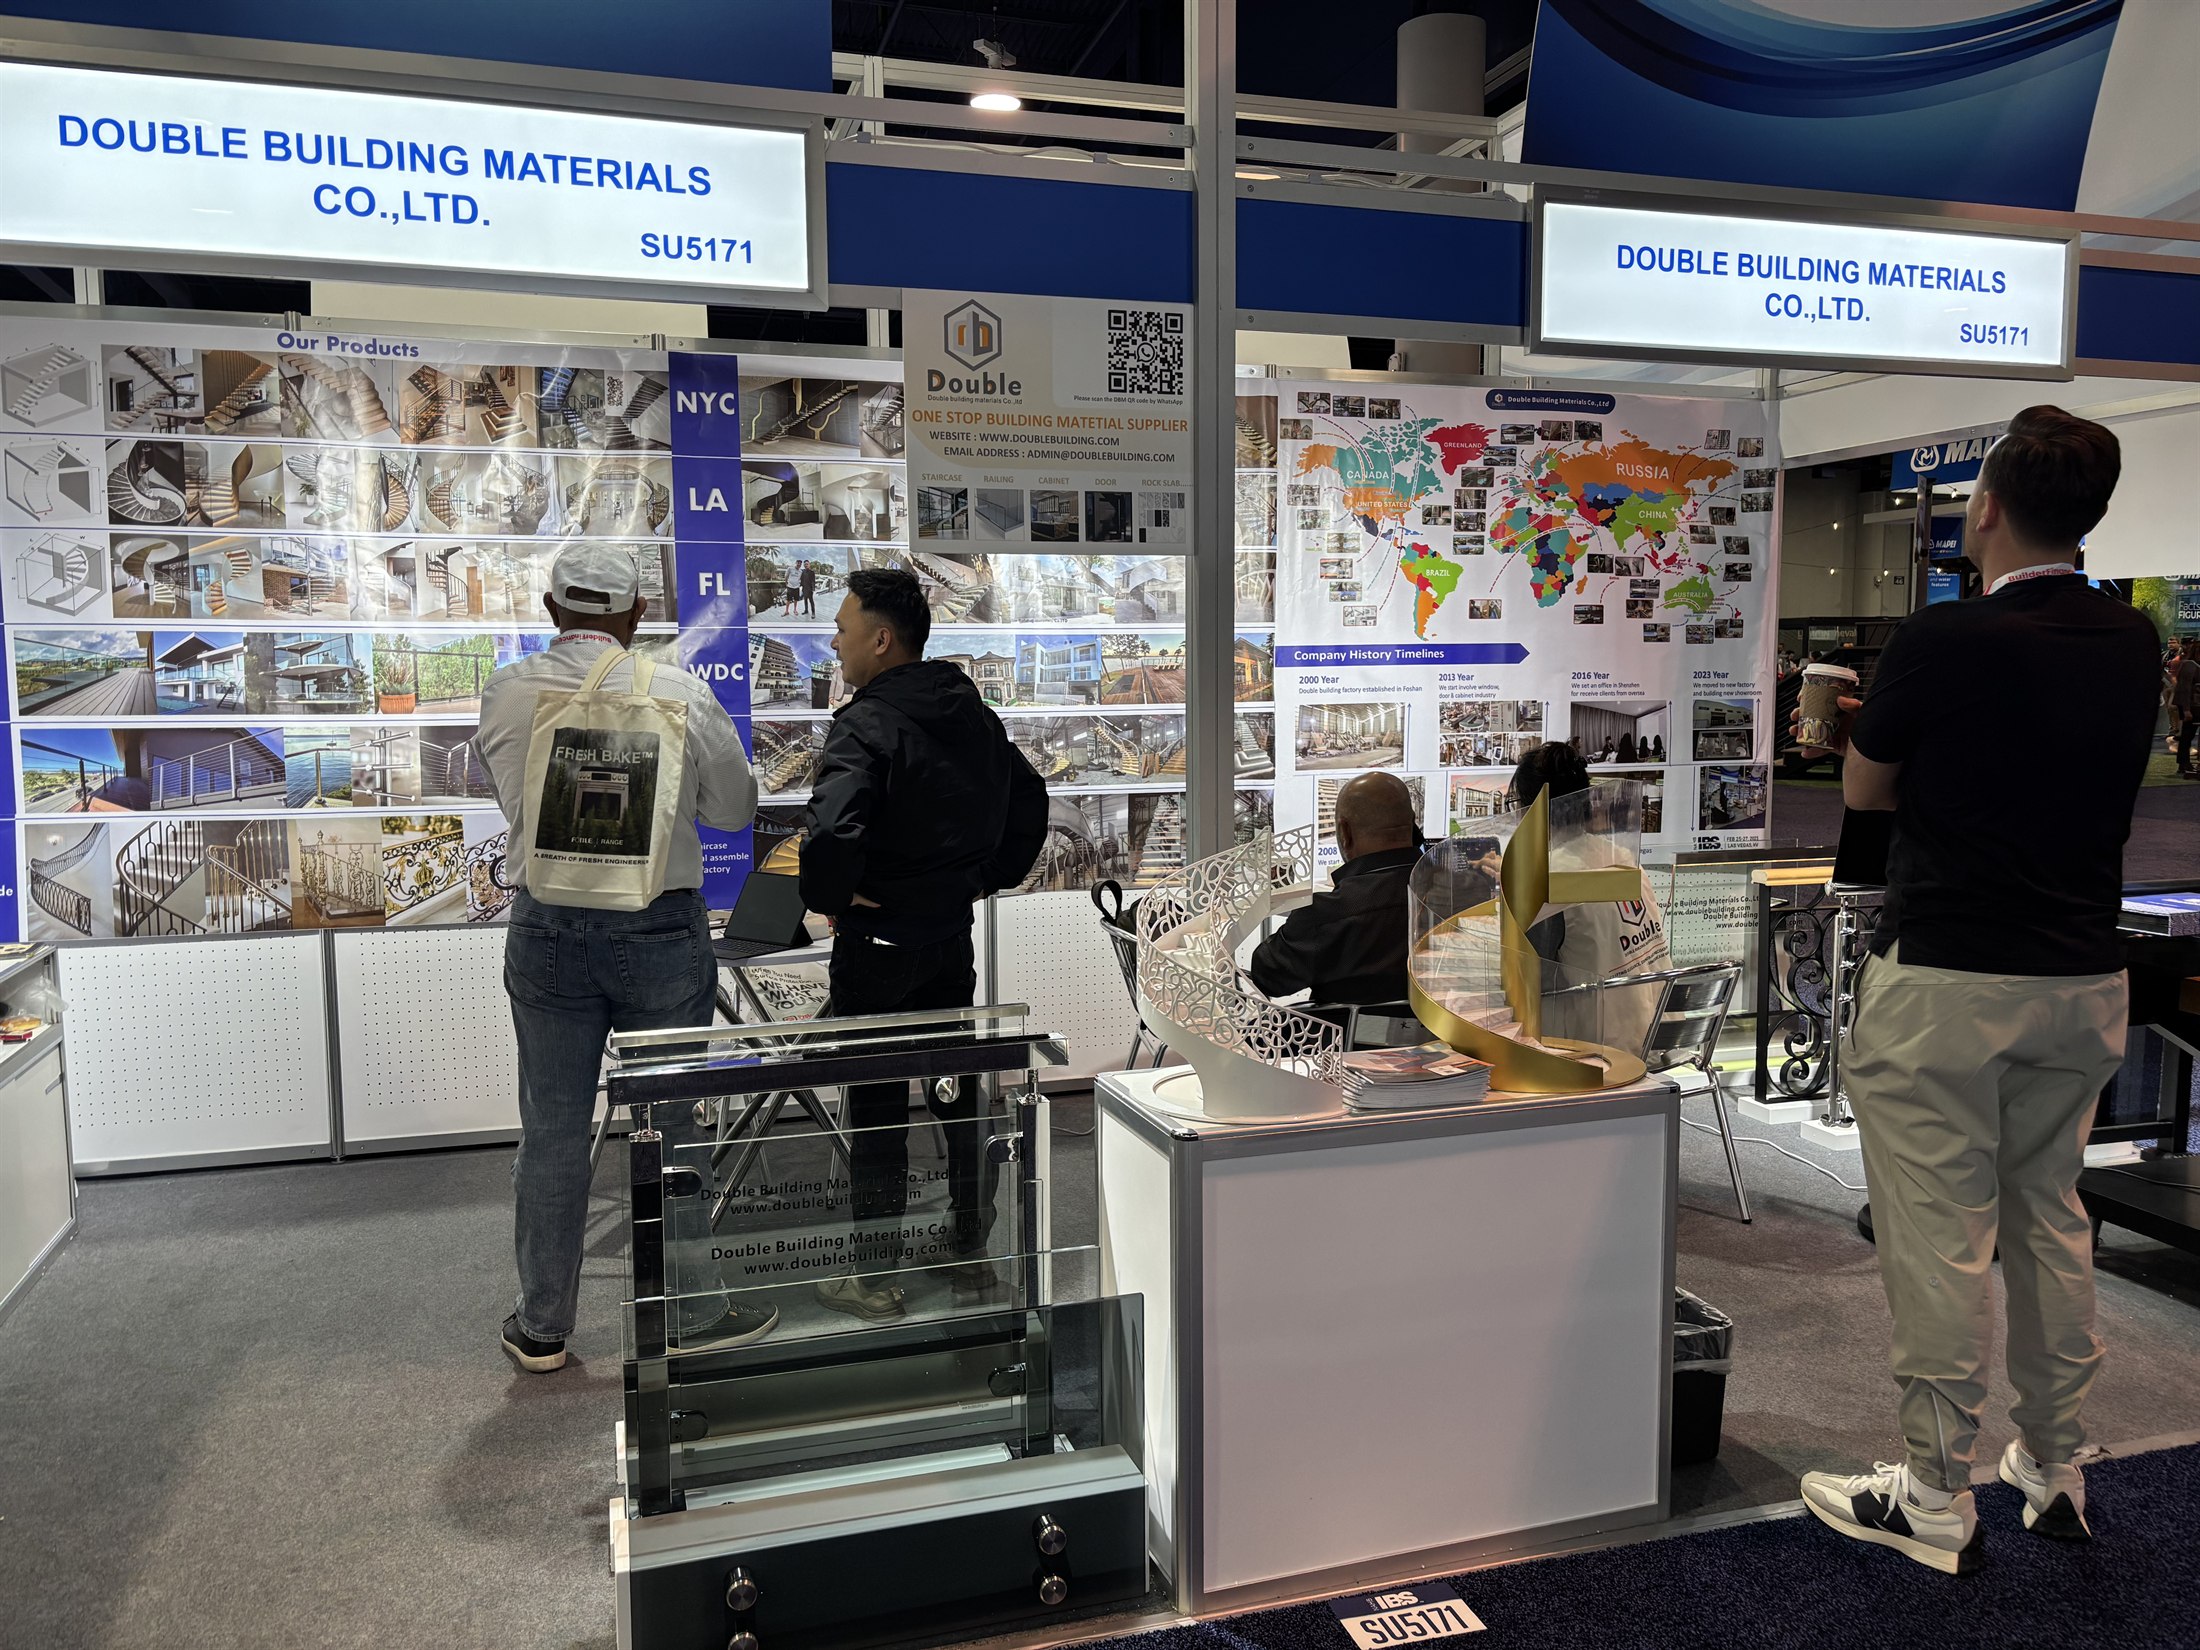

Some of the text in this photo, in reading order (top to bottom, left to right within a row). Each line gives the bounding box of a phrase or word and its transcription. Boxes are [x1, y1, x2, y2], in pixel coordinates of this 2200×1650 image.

[58, 113, 712, 197] DOUBLE BUILDING MATERIALS
[312, 183, 492, 227] CO.,LTD.
[639, 232, 754, 265] SU5171
[1616, 243, 2007, 294] DOUBLE BUILDING MATERIALS
[1764, 292, 1871, 323] CO.,LTD.
[1959, 322, 2030, 347] SU5171
[276, 332, 420, 359] Our Products
[927, 368, 1022, 396] Double
[676, 390, 736, 416] NYC
[927, 394, 949, 402] Double
[950, 395, 974, 404] building
[974, 396, 1001, 405] materials
[1126, 397, 1135, 405] QR
[1149, 398, 1156, 406] by
[1156, 398, 1184, 406] WhatsApp
[1532, 397, 1559, 405] Building
[1559, 397, 1587, 406] Materials
[912, 408, 1188, 433] ONE STOP BUILDING MATETIAL SUPPLIER
[929, 430, 972, 442] WEBSITE
[979, 432, 1120, 447] WWW.DOUBLEBUILDING.COM
[1443, 441, 1483, 449] GREENLAND
[944, 446, 975, 458] EMAIL
[976, 447, 1019, 459] ADDRESS
[1027, 448, 1176, 463] ADMIN@DOUBLEBUILDING.COM
[921, 472, 963, 483] STAIRCASE
[1346, 470, 1390, 479] CANADA
[1615, 462, 1671, 481] RUSSIA
[983, 474, 1015, 484] RAILING
[1038, 476, 1070, 486] CABINET
[1094, 478, 1117, 487] DOOR
[1141, 479, 1161, 487] ROCK
[689, 486, 729, 512] LA
[1638, 510, 1668, 519] CHINA
[1425, 568, 1451, 578] BRAZIL
[698, 572, 730, 596] FL
[1294, 648, 1445, 663] Company History Timelines
[689, 662, 743, 682] WDC
[1438, 673, 1475, 682] 2013 Year
[1571, 671, 1610, 680] 2016 Year
[1692, 671, 1729, 679] 2023 Year
[1299, 675, 1340, 684] 2000 Year
[1319, 687, 1342, 695] building
[1342, 686, 1362, 694] factory
[555, 746, 596, 761] FRESH
[600, 838, 624, 846] RANGE
[541, 854, 567, 862] BREATH
[709, 852, 750, 862] assemble
[1318, 847, 1338, 856] 2008
[1708, 897, 1740, 906] Materials
[1703, 911, 1759, 921] Double Building
[1619, 919, 1662, 951] Double
[758, 980, 830, 992] WE HAVE
[764, 990, 812, 1003] WHAT
[769, 997, 807, 1011] YOU
[700, 1181, 822, 1201] Double Building
[711, 1243, 771, 1260] Double
[776, 1236, 844, 1253] Building
[849, 1225, 924, 1245] Materials
[744, 1241, 953, 1275] www.doublebuilding.com
[1374, 1591, 1419, 1610] IBS
[1360, 1605, 1469, 1645] SU5171
